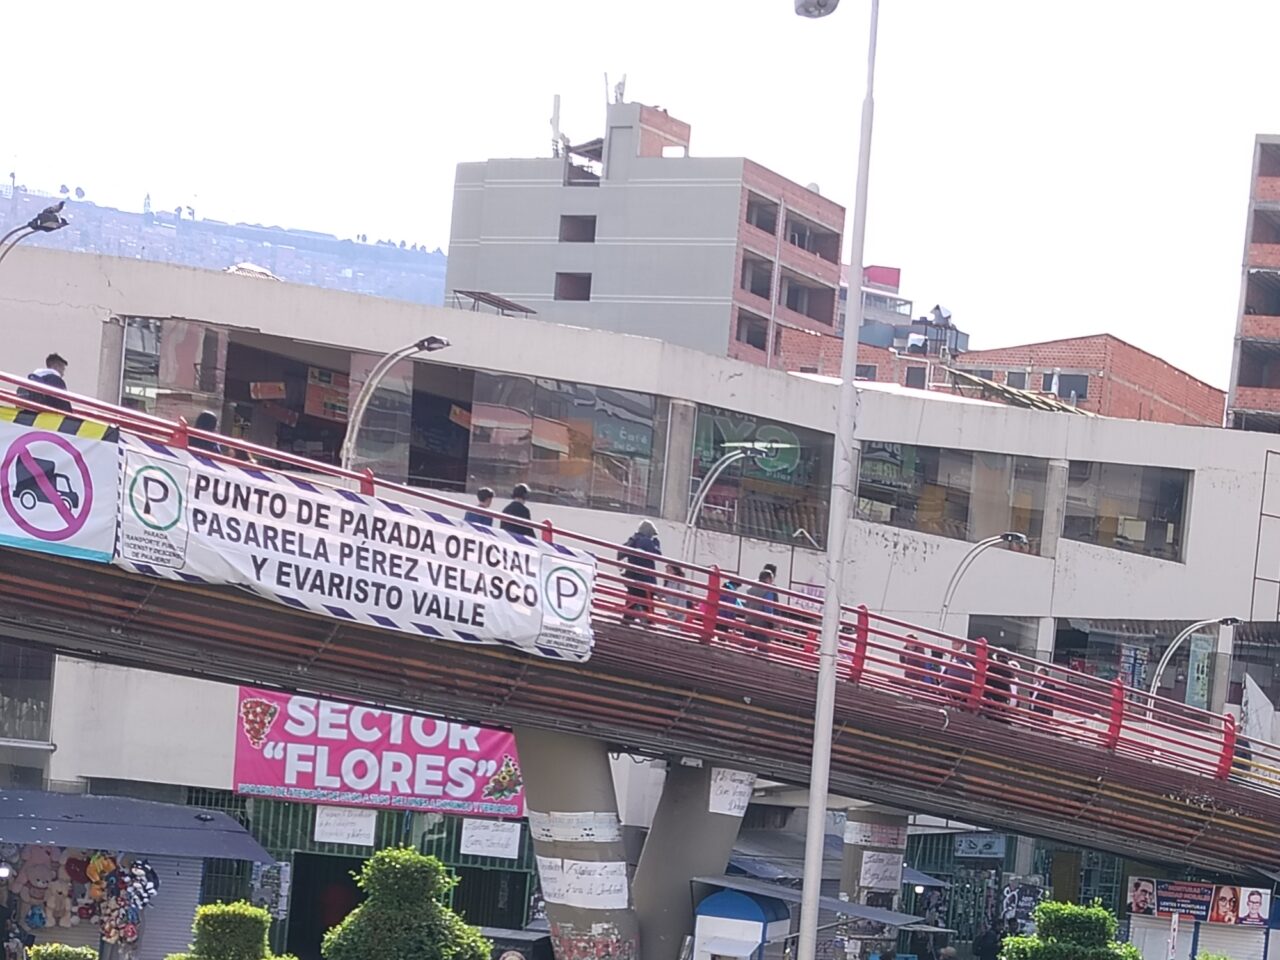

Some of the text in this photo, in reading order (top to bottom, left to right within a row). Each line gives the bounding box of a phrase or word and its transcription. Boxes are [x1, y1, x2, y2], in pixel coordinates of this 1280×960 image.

[192, 508, 538, 608] PASARELA PÉREZ VELASCO
[194, 474, 537, 579] PUNTO DE PARADA OFICIAL
[251, 555, 486, 628] Y EVARISTO VALLE
[284, 695, 481, 752] SECTOR
